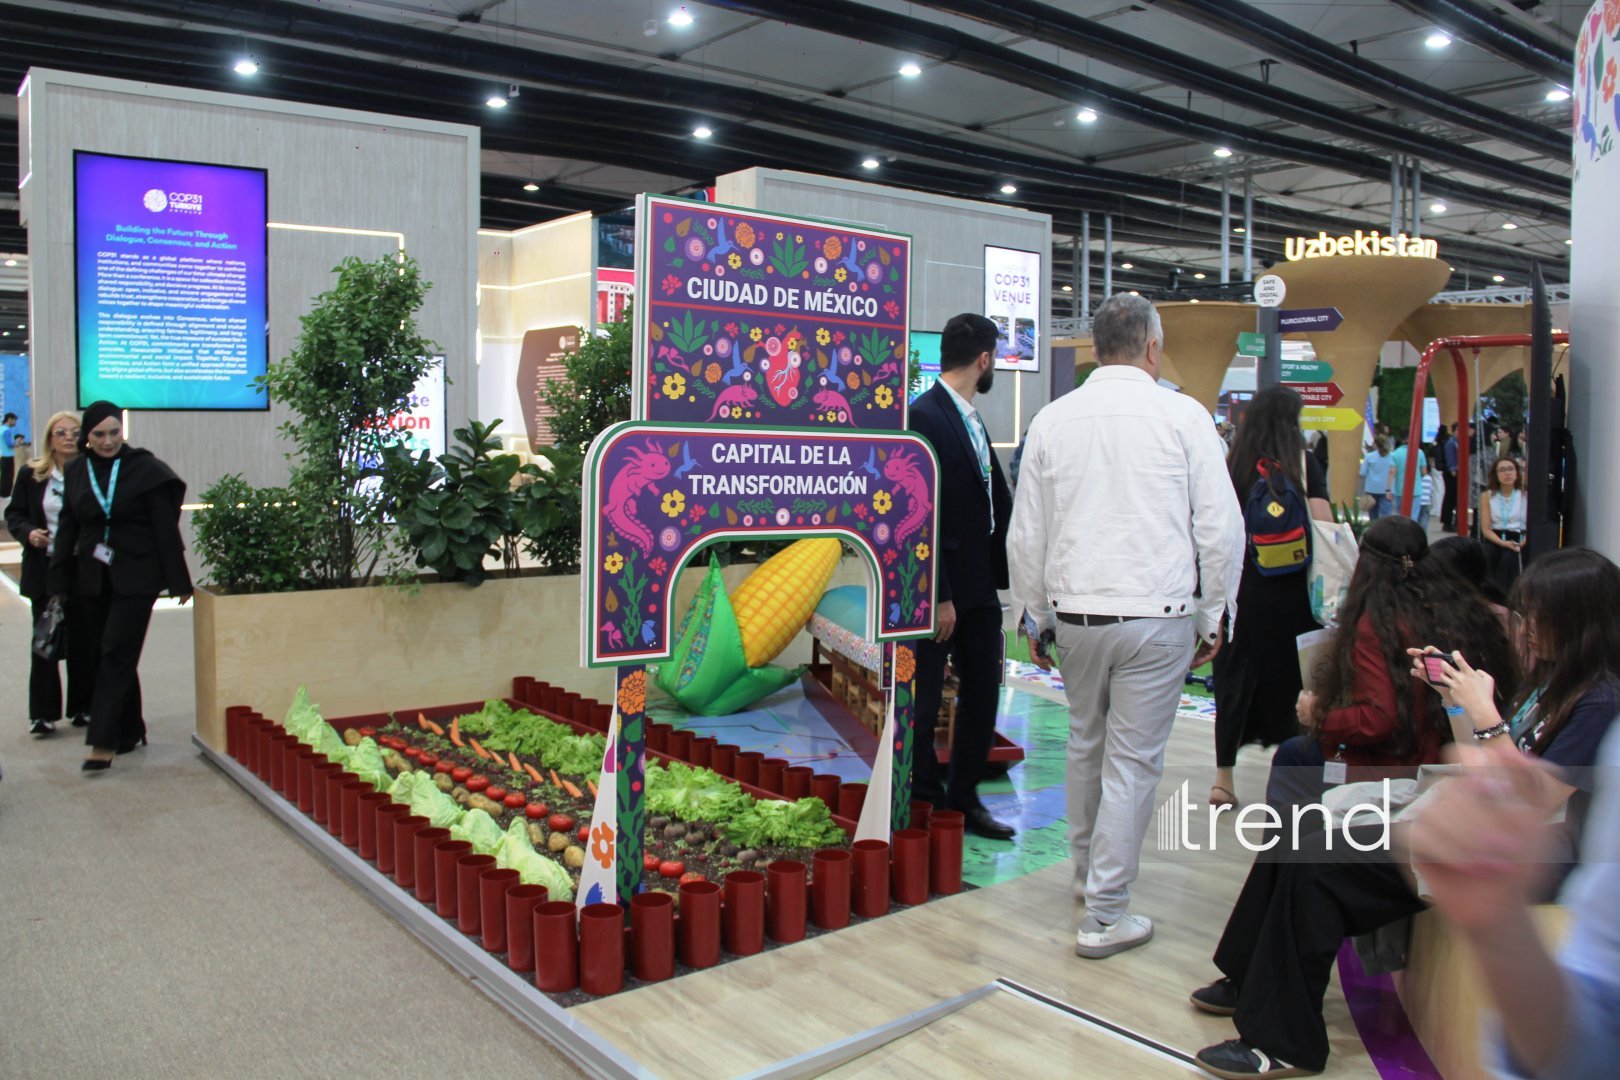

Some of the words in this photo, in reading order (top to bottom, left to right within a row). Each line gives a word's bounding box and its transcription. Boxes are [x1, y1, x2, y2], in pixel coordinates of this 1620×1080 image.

[169, 192, 202, 203] COP31
[116, 224, 150, 235] Building
[167, 228, 193, 236] Future
[195, 230, 228, 240] Through
[106, 234, 145, 244] Dialogue,
[147, 237, 193, 247] Consensus,
[1285, 230, 1438, 261] Uzbekistan
[994, 273, 1030, 288] COP31
[687, 276, 768, 306] CIUDAD
[774, 286, 799, 309] DE
[804, 288, 878, 318] MÉXICO
[994, 289, 1031, 304] VENUE
[1281, 316, 1317, 325] PLURICULTURAL
[711, 442, 795, 464] CAPITAL
[801, 445, 823, 464] DE
[828, 446, 851, 465] LA
[688, 470, 867, 494] TRANSFORMACIÓN
